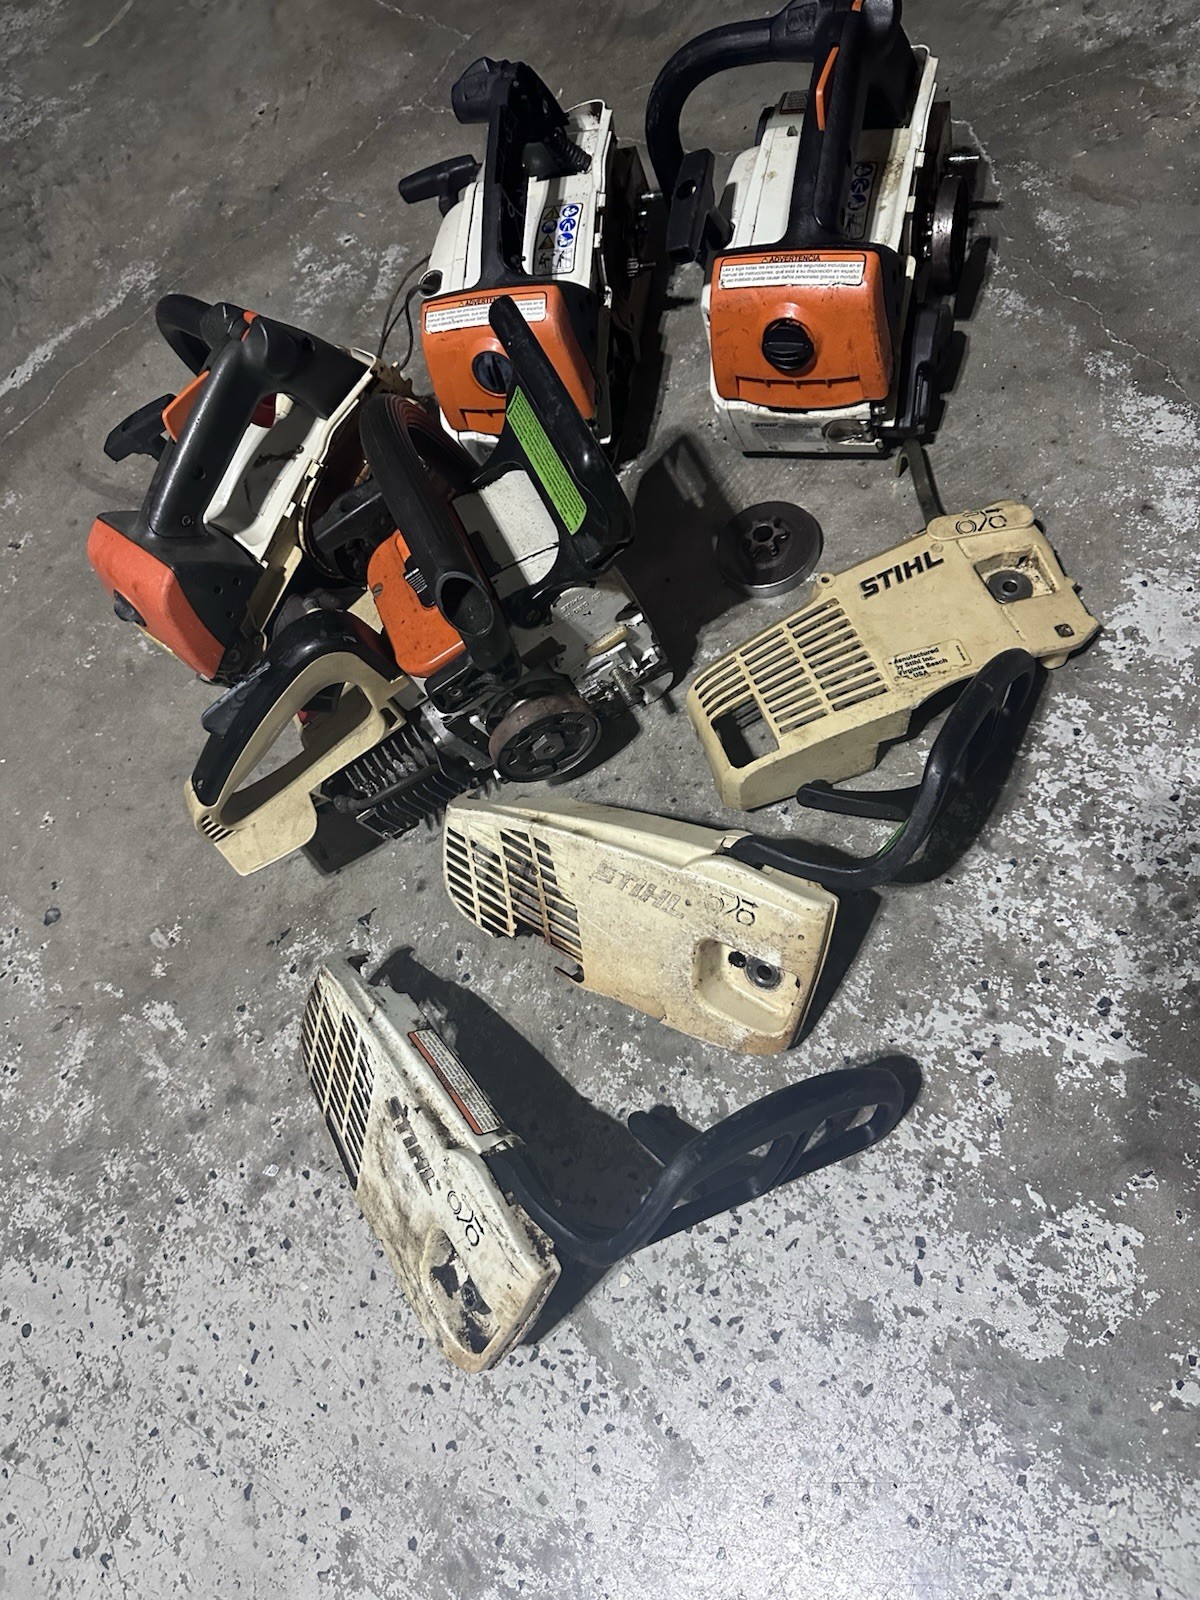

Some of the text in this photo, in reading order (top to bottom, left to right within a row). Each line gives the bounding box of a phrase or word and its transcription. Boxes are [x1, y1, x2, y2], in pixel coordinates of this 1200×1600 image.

[768, 255, 820, 263] ADVERTENCIA
[859, 551, 945, 600] STIHL
[893, 647, 939, 664] Manufactured
[905, 658, 921, 668] Stihl
[922, 655, 936, 664] Inc.
[898, 658, 948, 676] Virginia Beach
[912, 669, 929, 678] USA
[592, 861, 685, 920] STIHL
[388, 1096, 433, 1196] STIHL
